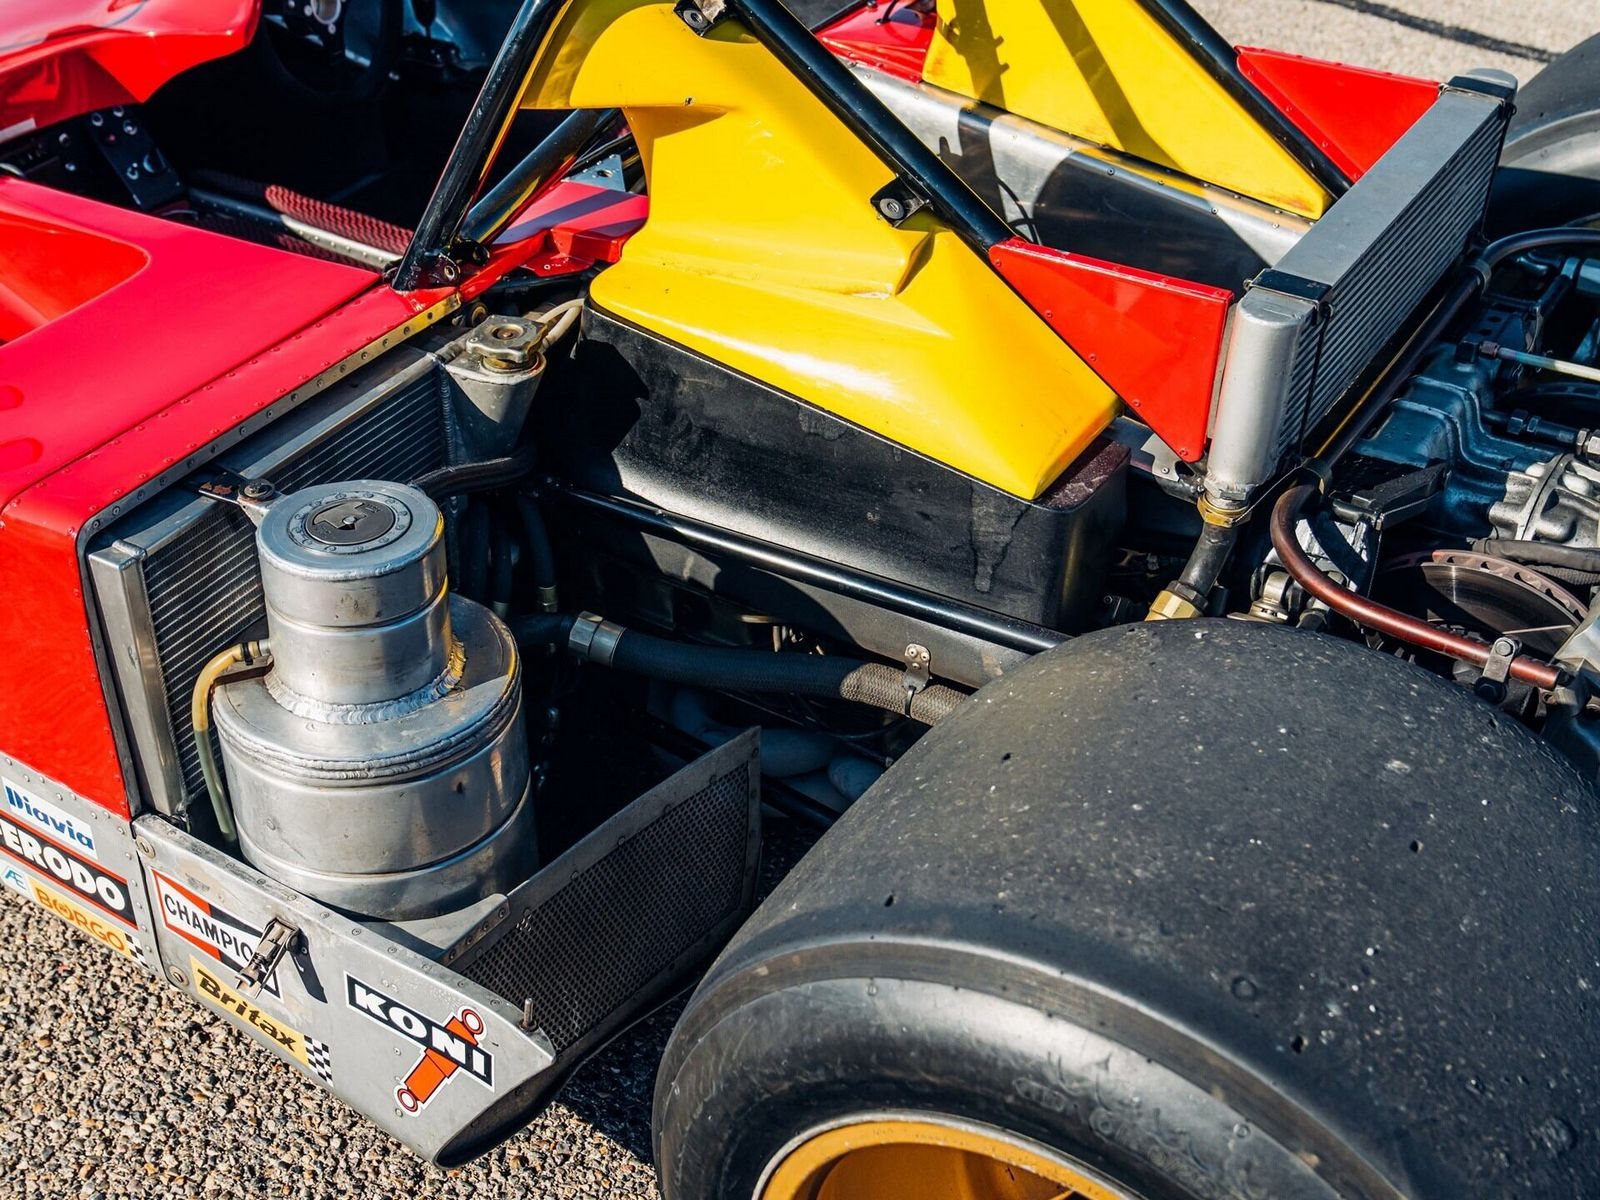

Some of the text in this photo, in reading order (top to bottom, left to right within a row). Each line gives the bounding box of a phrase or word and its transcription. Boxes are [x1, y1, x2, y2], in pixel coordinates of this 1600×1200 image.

[5, 785, 95, 851] Diavia
[0, 820, 126, 911] ERODO
[164, 893, 262, 968] CHAMPIO
[197, 967, 297, 1053] Britax
[354, 983, 487, 1078] KONI
